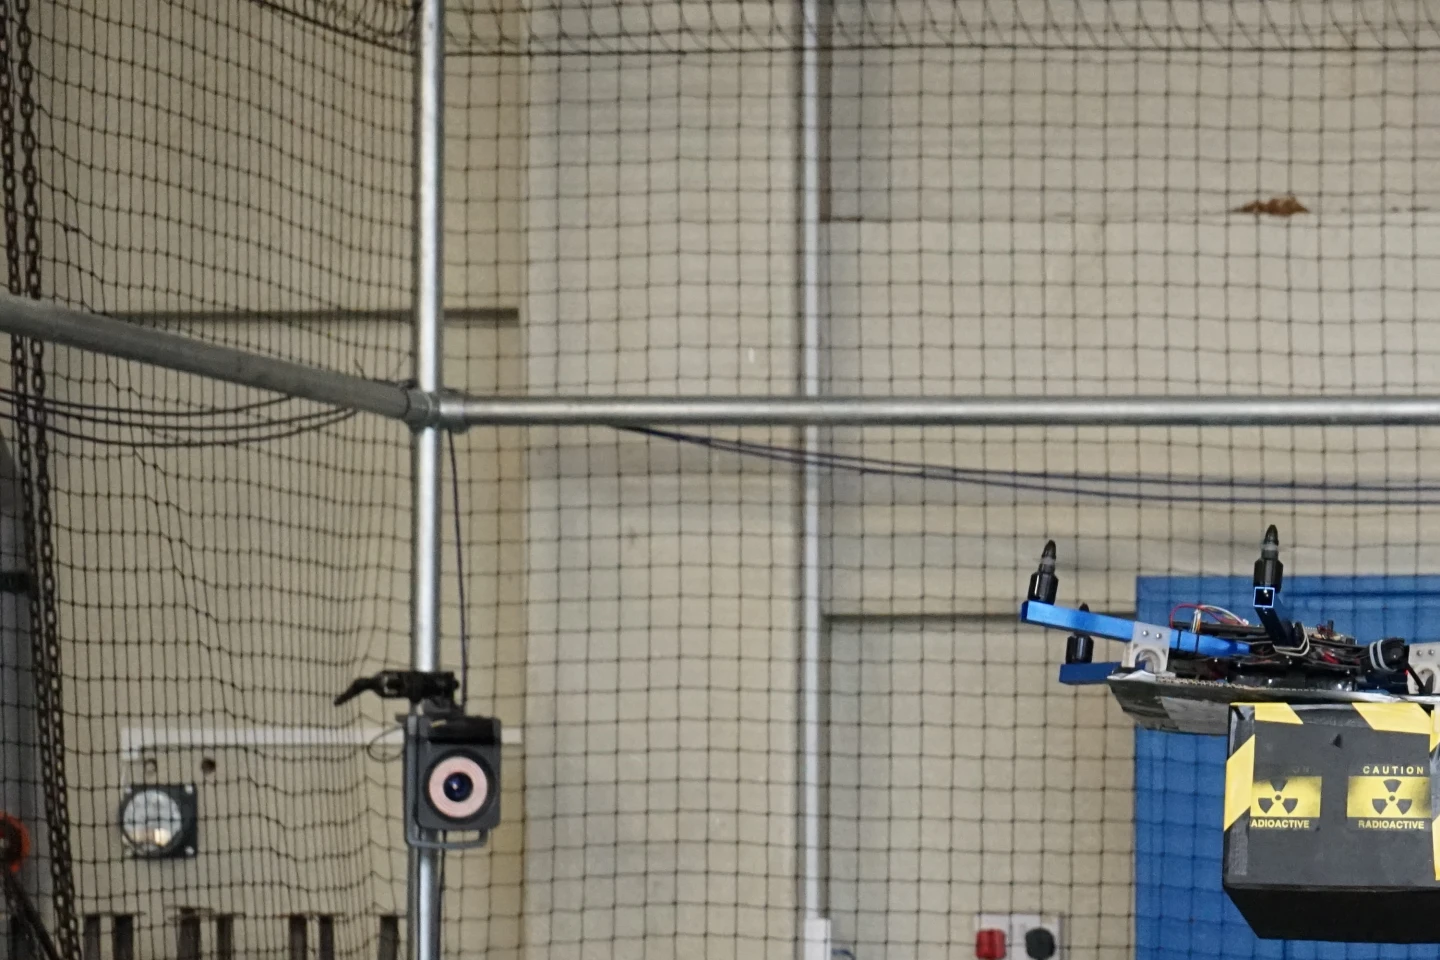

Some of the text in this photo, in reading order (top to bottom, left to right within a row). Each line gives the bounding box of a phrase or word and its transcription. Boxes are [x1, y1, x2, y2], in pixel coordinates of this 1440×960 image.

[1362, 765, 1424, 775] CAUTION
[1250, 818, 1310, 829] ADIOACTIVE
[1358, 819, 1425, 830] RADIOACTIVE
